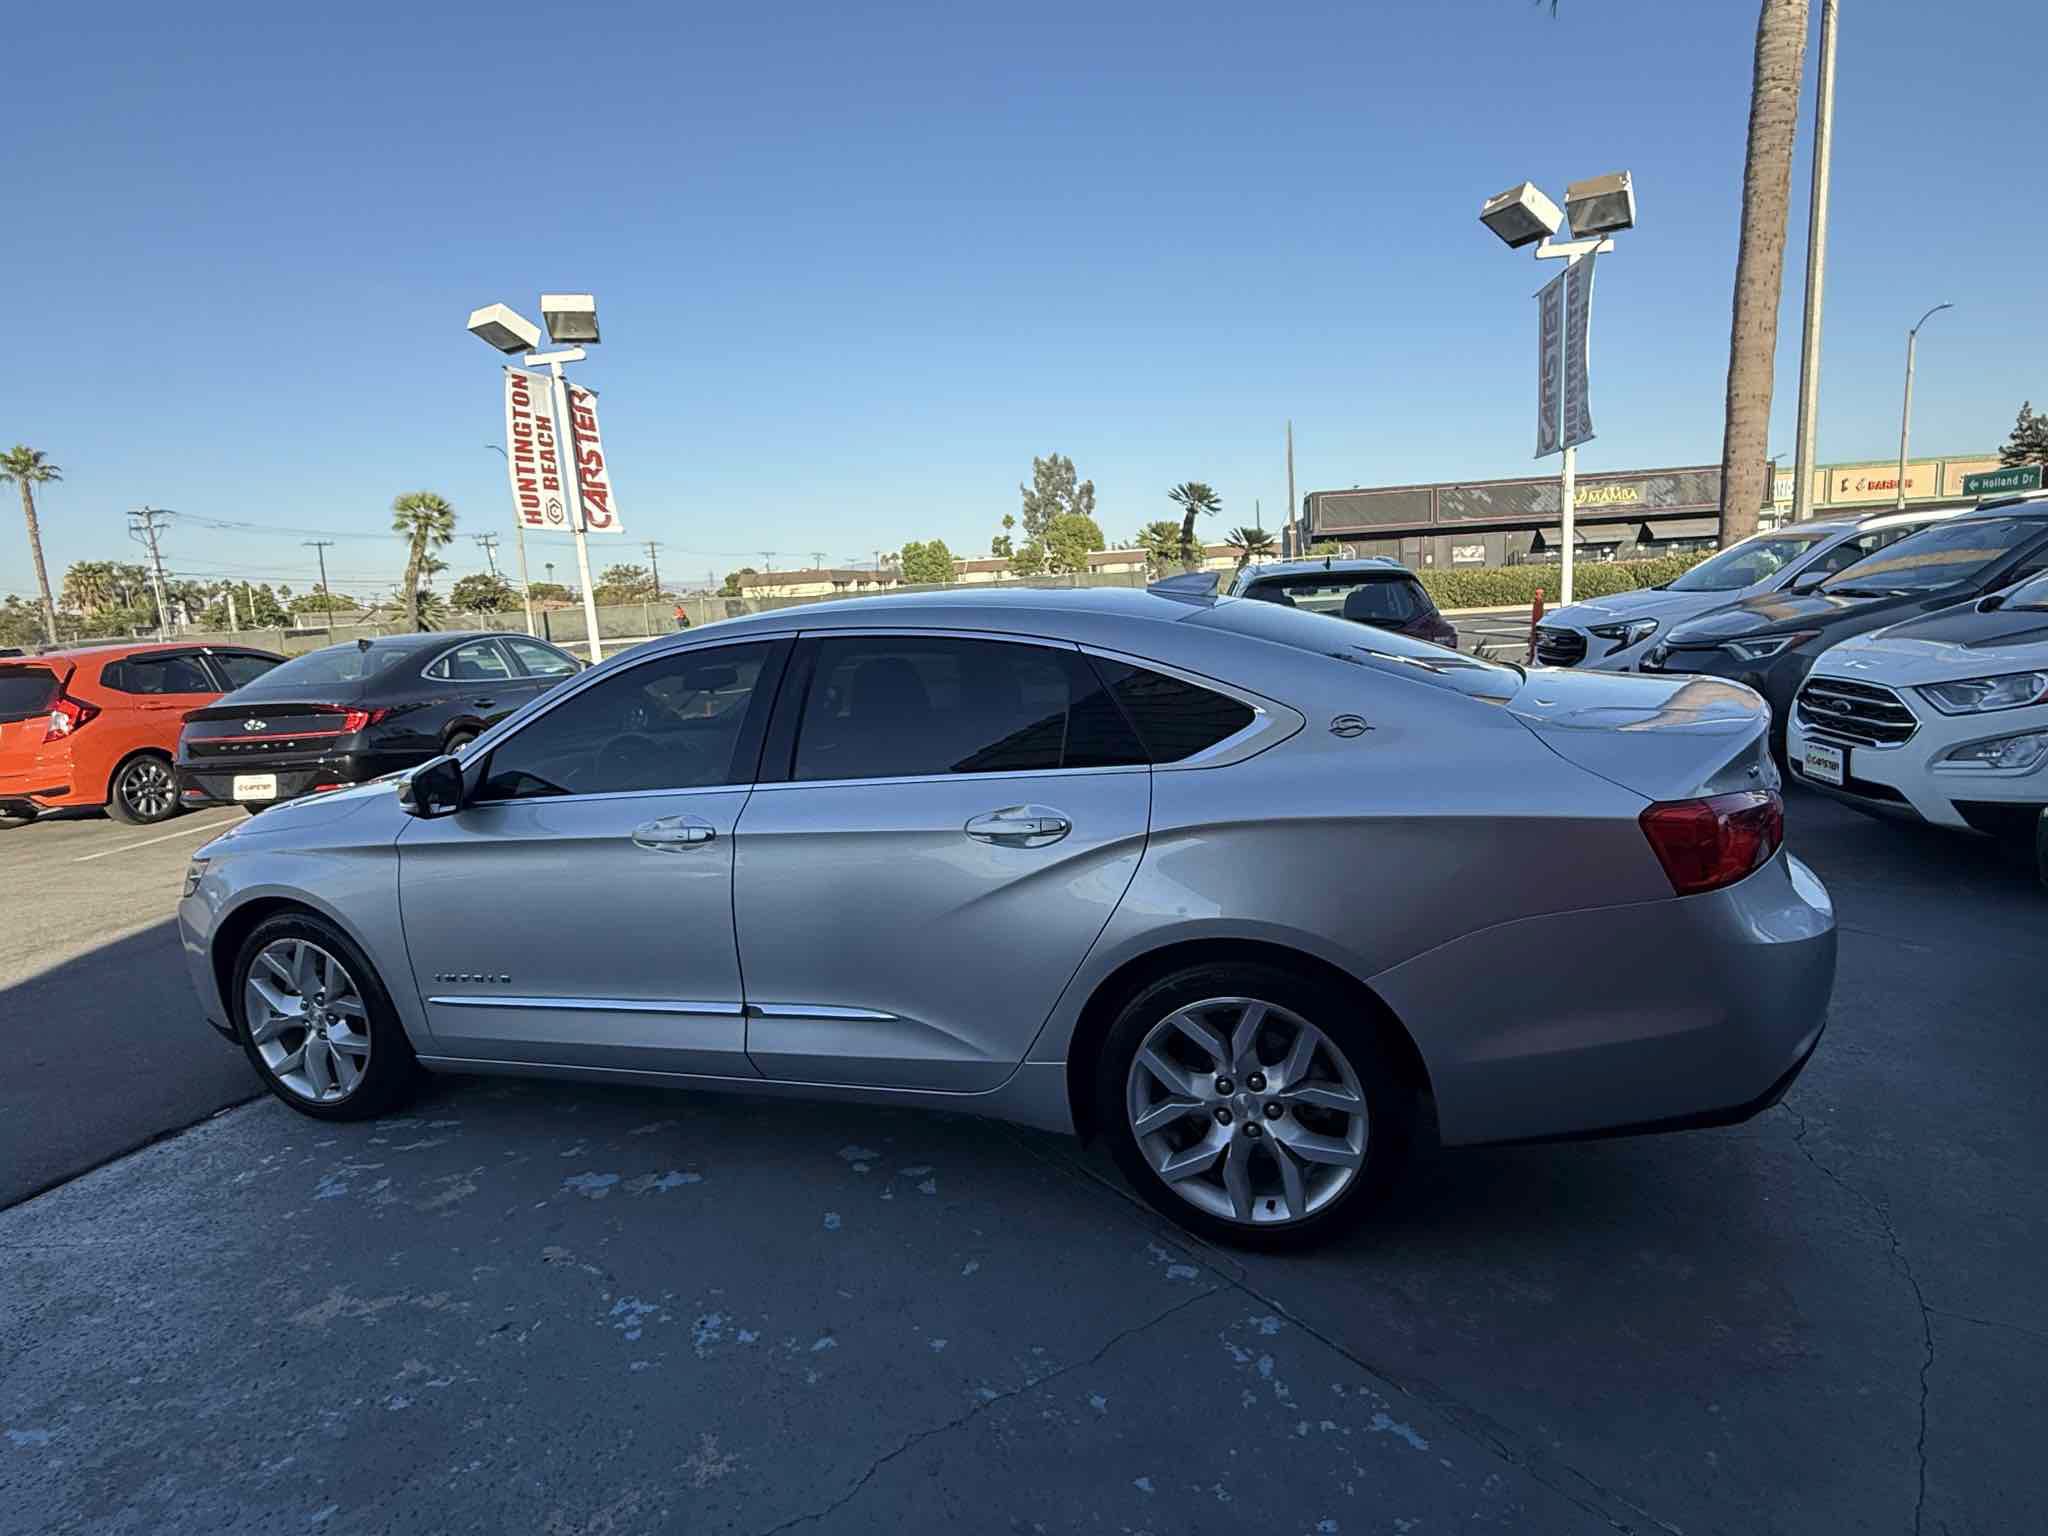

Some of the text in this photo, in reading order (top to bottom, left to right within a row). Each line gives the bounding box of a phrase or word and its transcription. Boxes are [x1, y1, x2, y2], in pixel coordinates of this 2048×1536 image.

[511, 373, 544, 525] HUNTINGTON
[536, 415, 560, 491] BEACH
[570, 389, 612, 529] CARSTER
[1982, 473, 2034, 488] Holland Dr
